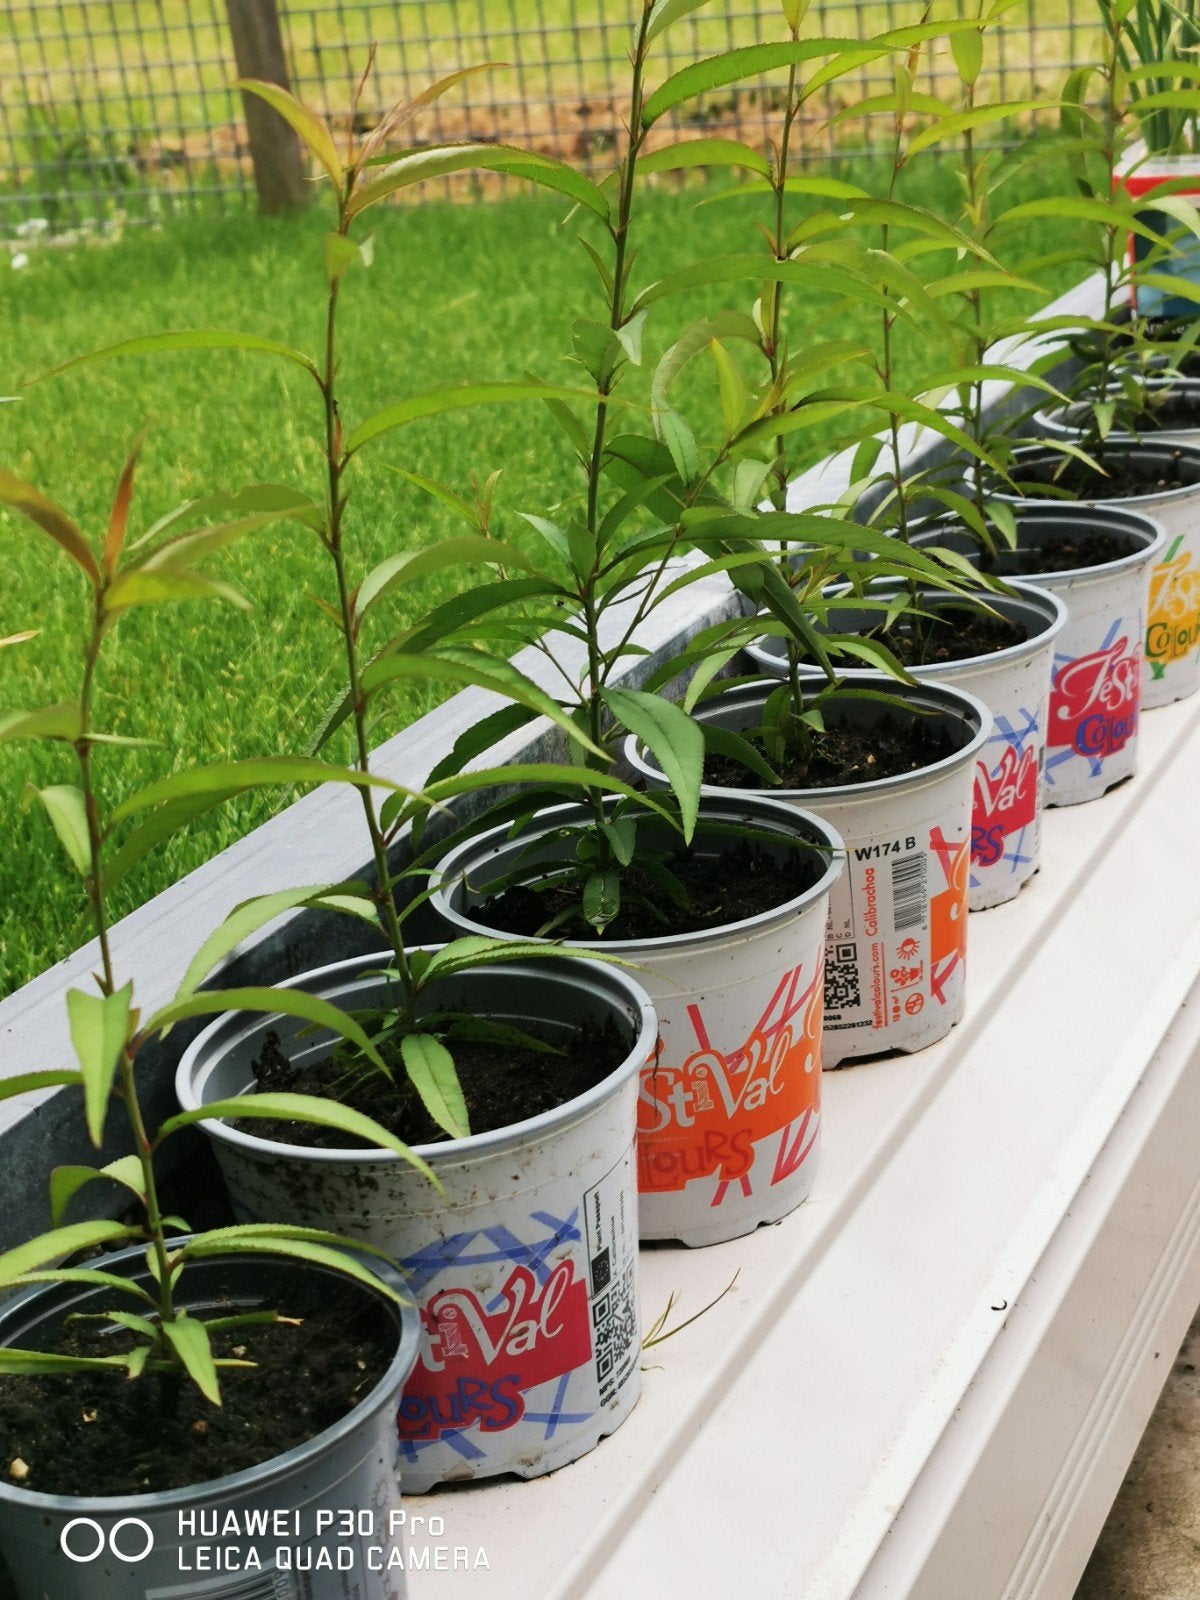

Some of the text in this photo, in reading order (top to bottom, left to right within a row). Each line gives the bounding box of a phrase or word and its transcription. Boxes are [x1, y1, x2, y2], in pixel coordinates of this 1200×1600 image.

[855, 836, 916, 861] W174 B
[862, 867, 877, 937] Calibrachoa
[871, 942, 882, 1031] festivalcolours.com
[400, 1374, 521, 1437] OURS
